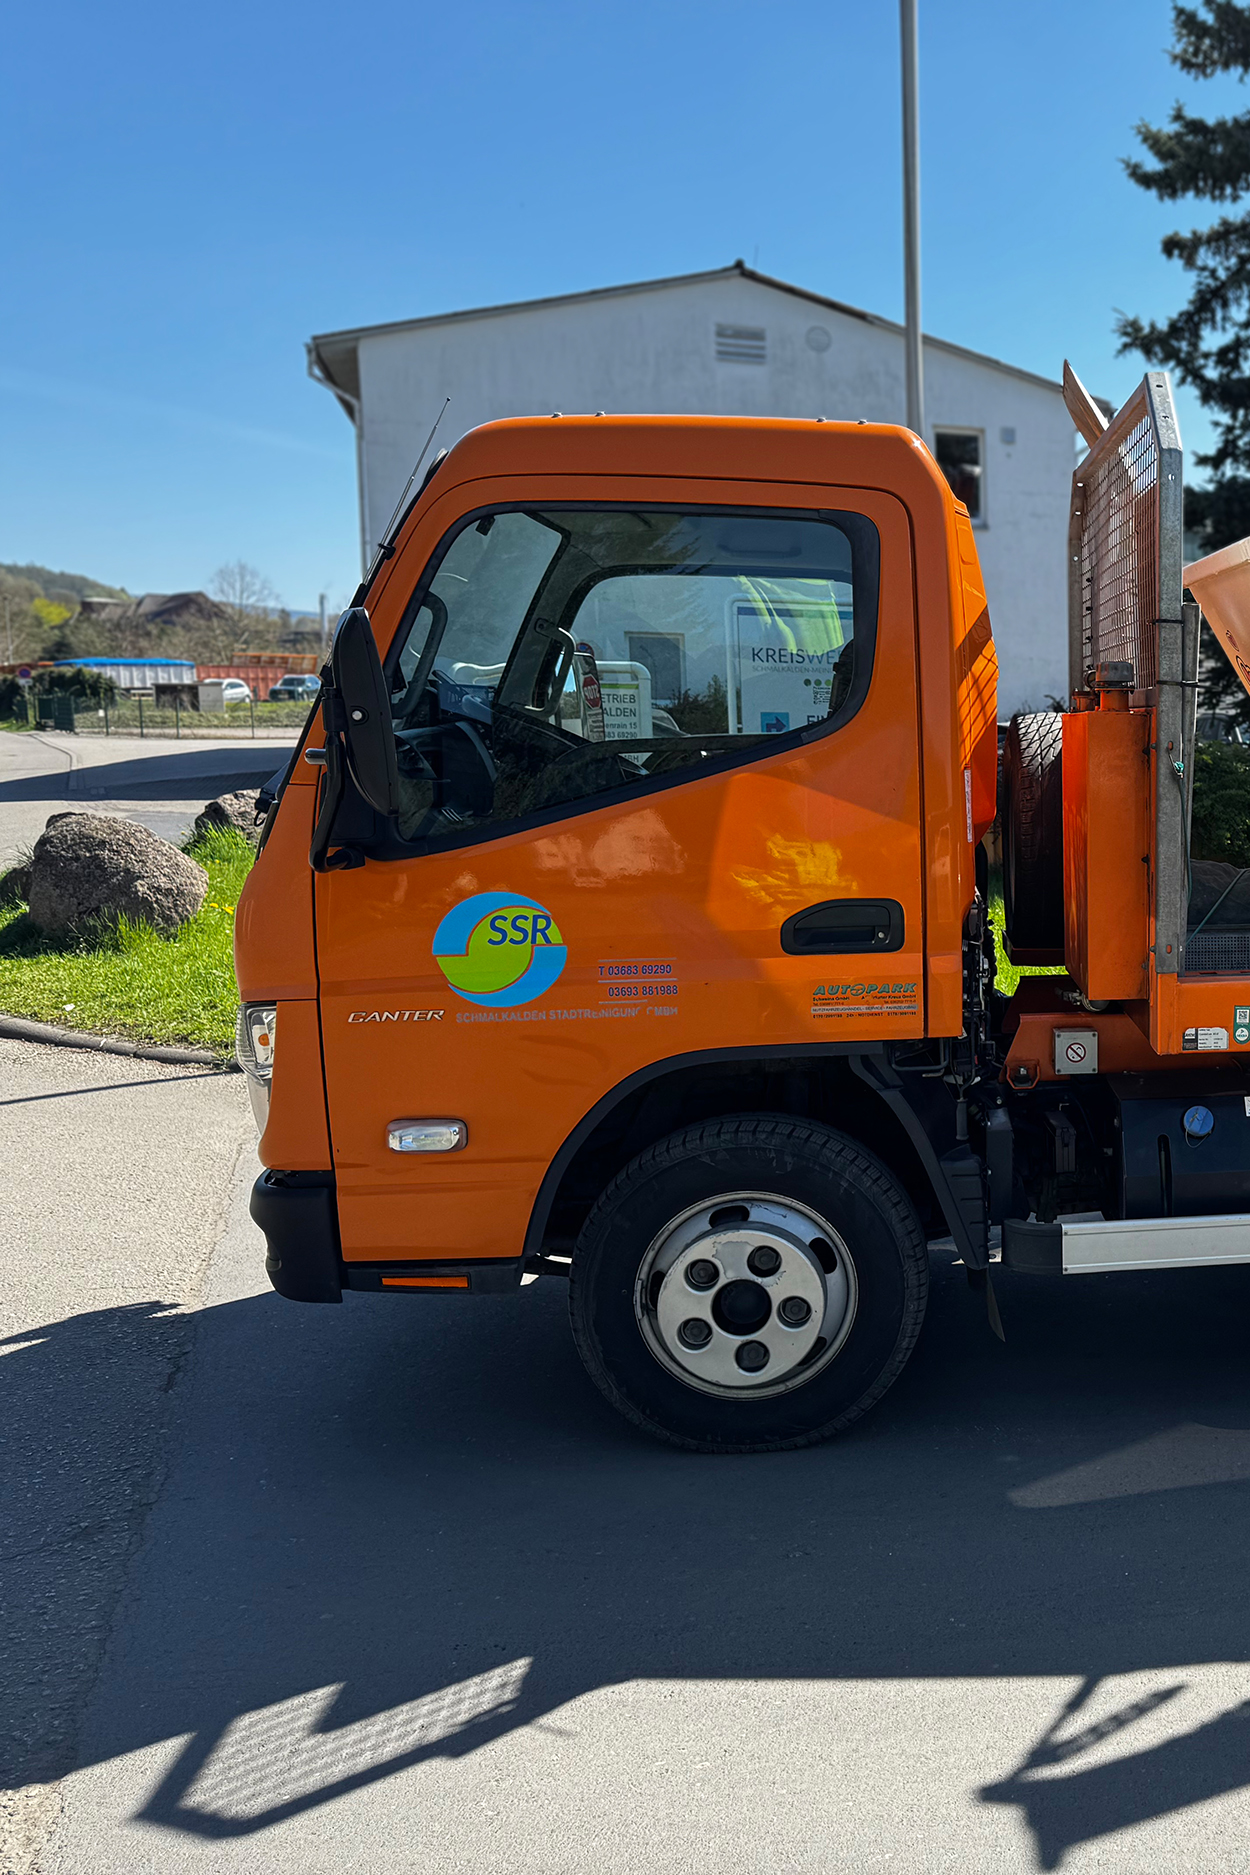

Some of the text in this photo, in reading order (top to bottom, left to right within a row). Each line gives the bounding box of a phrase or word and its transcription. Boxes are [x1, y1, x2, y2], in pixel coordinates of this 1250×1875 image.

[487, 914, 552, 946] SSR
[598, 964, 672, 976] T 03683 69290
[608, 984, 678, 997] 03693 881988
[347, 1009, 445, 1023] CANTER
[455, 1011, 546, 1024] SCHMALKALDEN
